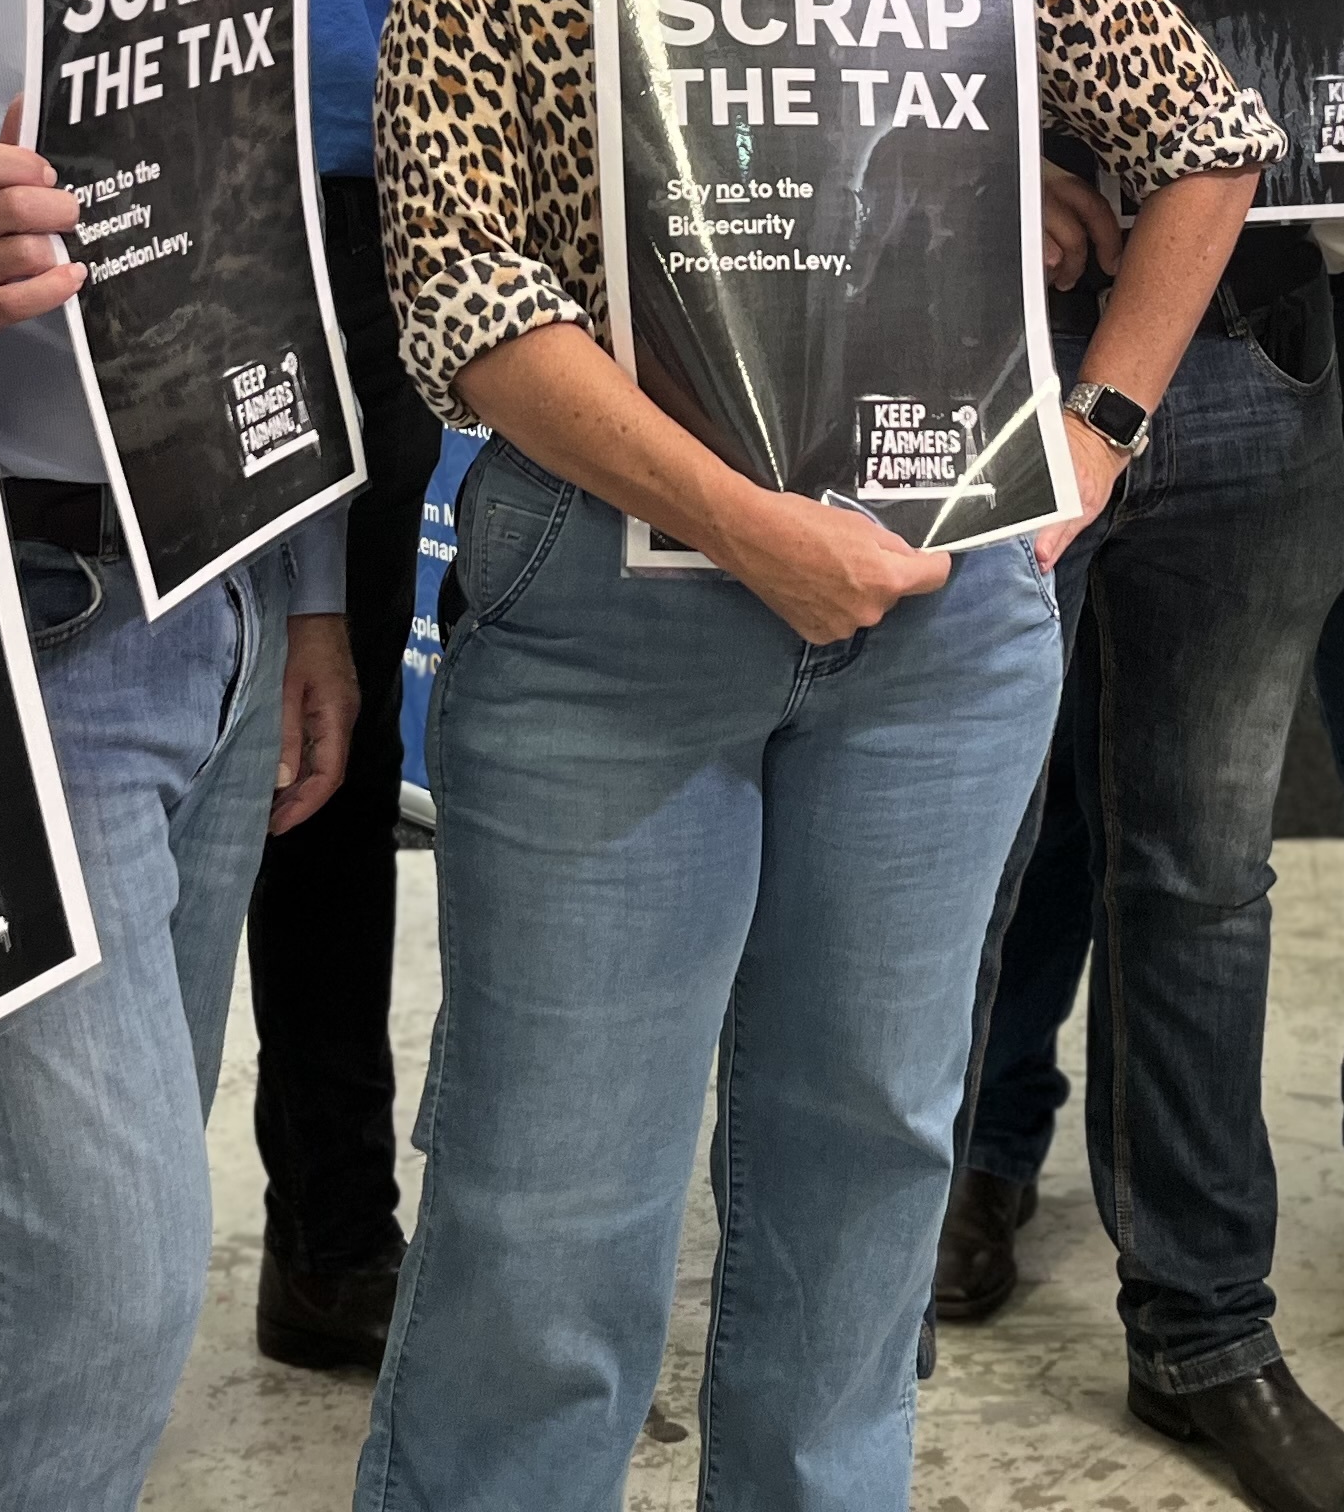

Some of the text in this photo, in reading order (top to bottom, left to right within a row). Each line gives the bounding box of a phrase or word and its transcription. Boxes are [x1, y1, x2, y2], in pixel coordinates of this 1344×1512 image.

[60, 7, 276, 125] THE TAX
[653, 67, 990, 131] THE TAX
[96, 177, 118, 201] no
[116, 169, 134, 190] to
[135, 160, 161, 184] the
[667, 176, 814, 205] Say no to the
[75, 204, 152, 246] Biosecurity
[667, 213, 796, 240] Biosecurity
[89, 231, 194, 285] Protection Levy.
[669, 248, 852, 276] Protection Levy.
[232, 364, 267, 401] KEEP
[874, 403, 926, 428] KEEP
[870, 429, 961, 455] FARMERS
